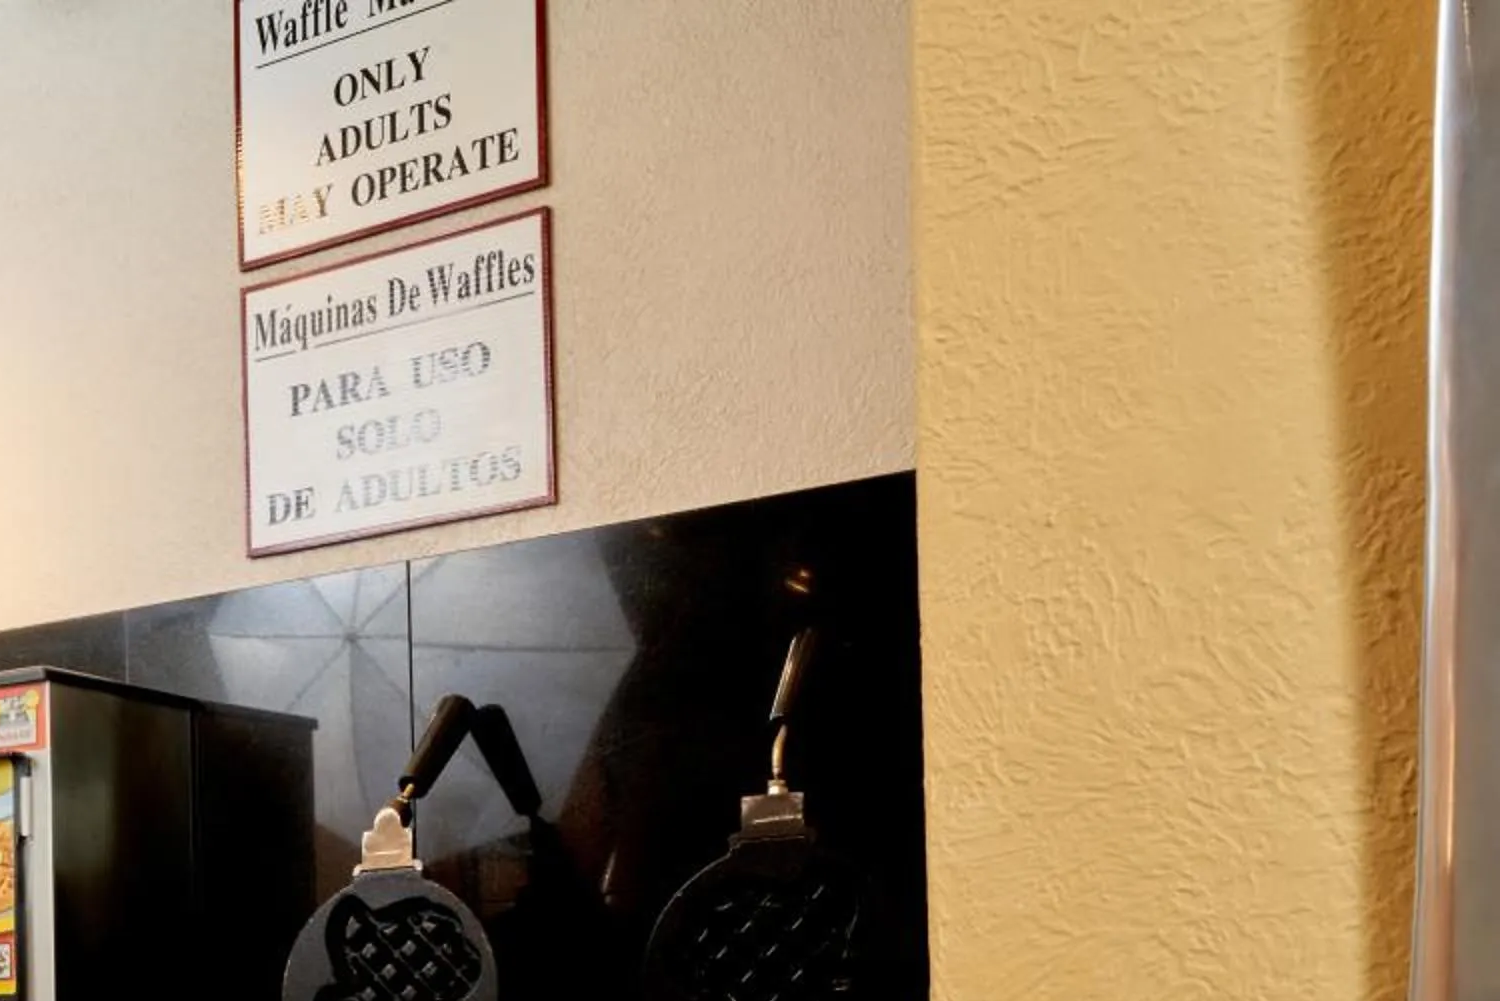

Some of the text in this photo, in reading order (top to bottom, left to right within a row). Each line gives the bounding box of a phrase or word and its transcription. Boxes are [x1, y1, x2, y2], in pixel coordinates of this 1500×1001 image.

[255, 0, 348, 55] Waffle
[333, 46, 431, 107] ONLY
[315, 93, 452, 166] ADULTS
[258, 127, 519, 235] MAY OPERATE
[254, 249, 535, 351] Máquinas De Waffles
[290, 341, 492, 417] PARA USO
[335, 407, 442, 461] SOLO
[266, 445, 522, 526] DE ADULTOS
